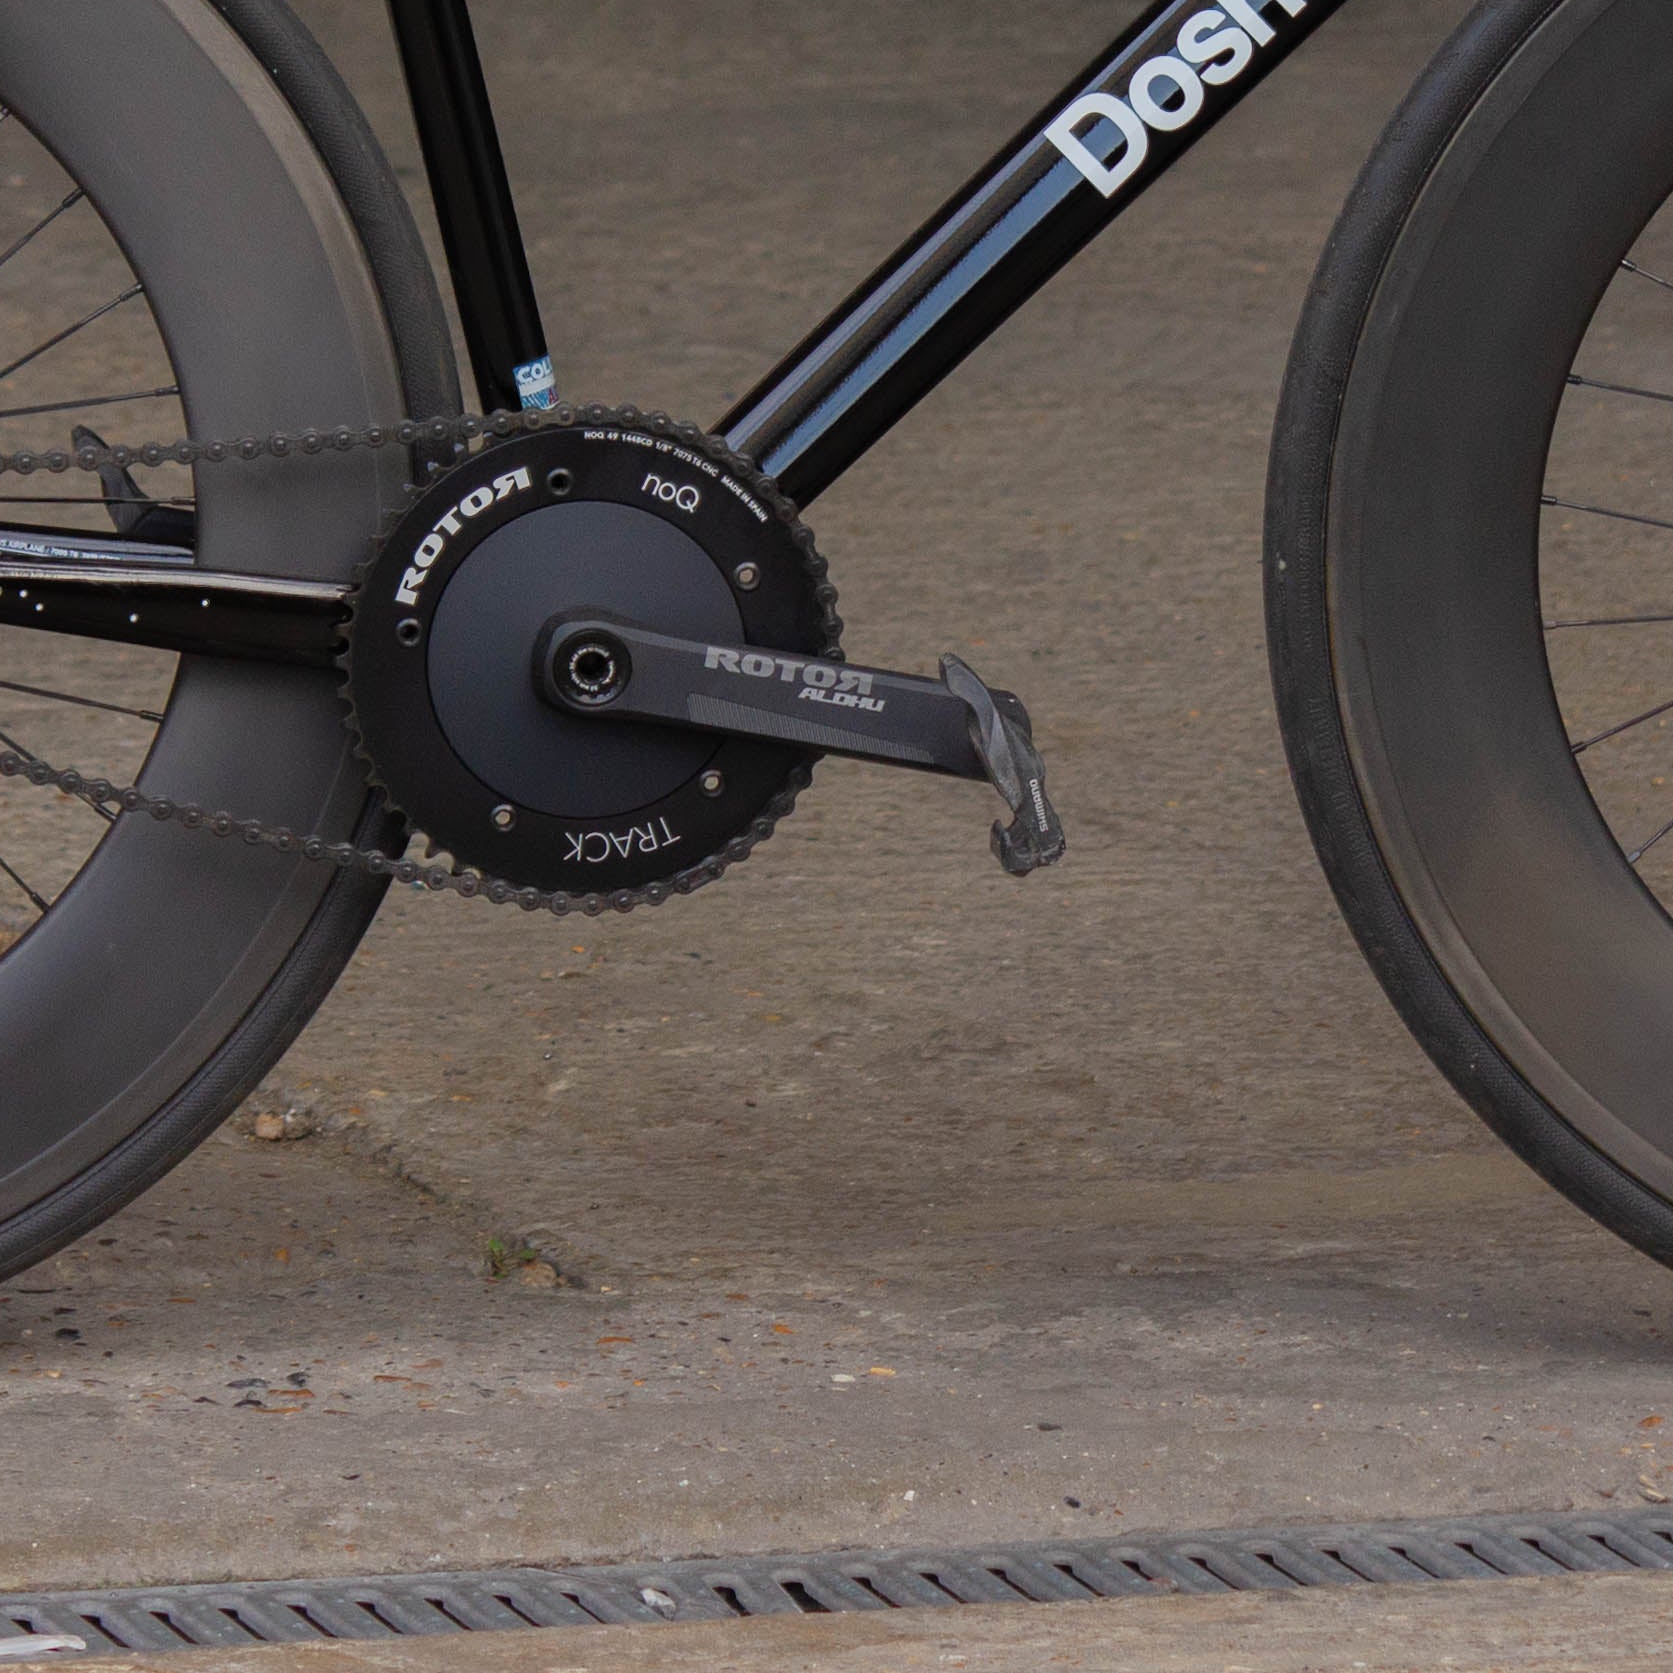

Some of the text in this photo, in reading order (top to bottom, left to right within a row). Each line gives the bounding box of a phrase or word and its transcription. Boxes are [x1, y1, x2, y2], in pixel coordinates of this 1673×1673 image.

[720, 474, 742, 497] MADE
[747, 500, 769, 523] SPAIN
[395, 466, 531, 607] ROTOR
[704, 646, 874, 696] ROTOR
[798, 686, 886, 712] ALDHU
[562, 816, 682, 865] TRACK
